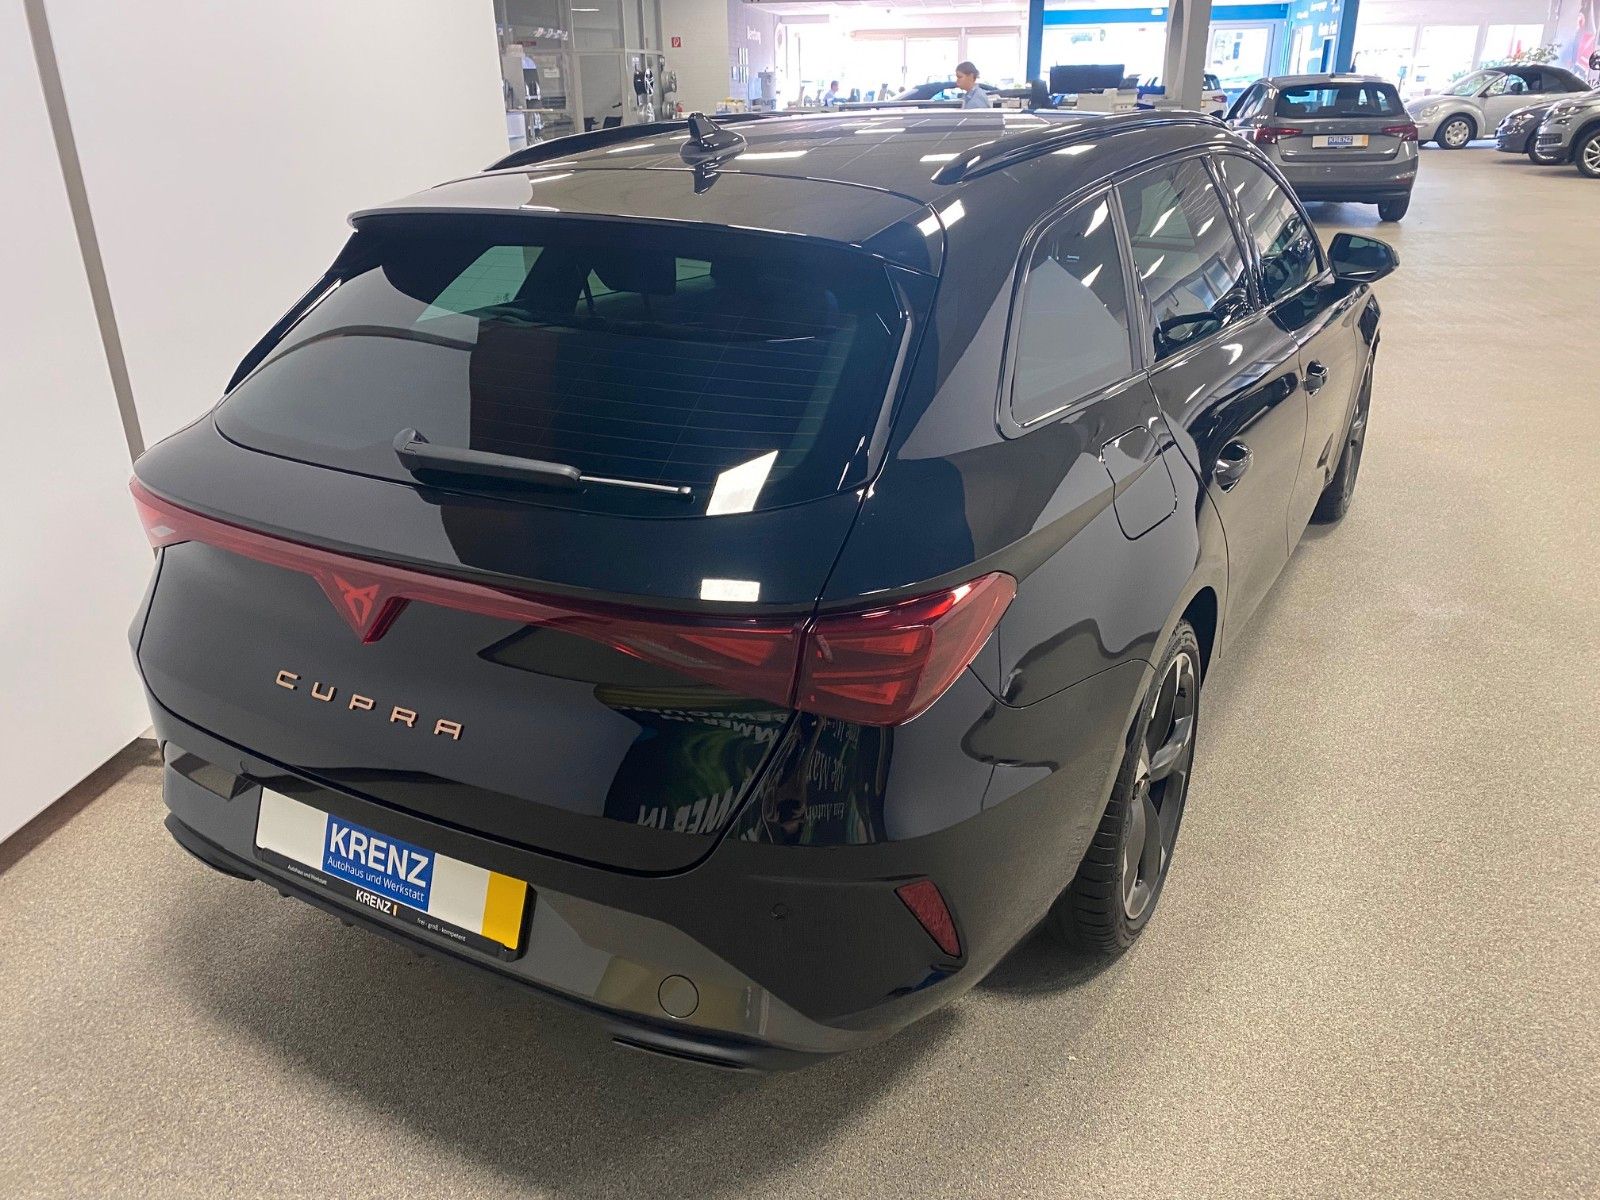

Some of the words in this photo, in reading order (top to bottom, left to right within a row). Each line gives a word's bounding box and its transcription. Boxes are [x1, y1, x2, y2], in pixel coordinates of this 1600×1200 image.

[275, 670, 463, 740] CUPRA
[327, 856, 364, 879] Autohaus
[365, 872, 382, 885] und
[383, 878, 424, 902] Werkstatt
[329, 823, 429, 888] KRENZ
[356, 889, 392, 914] KRENZ
